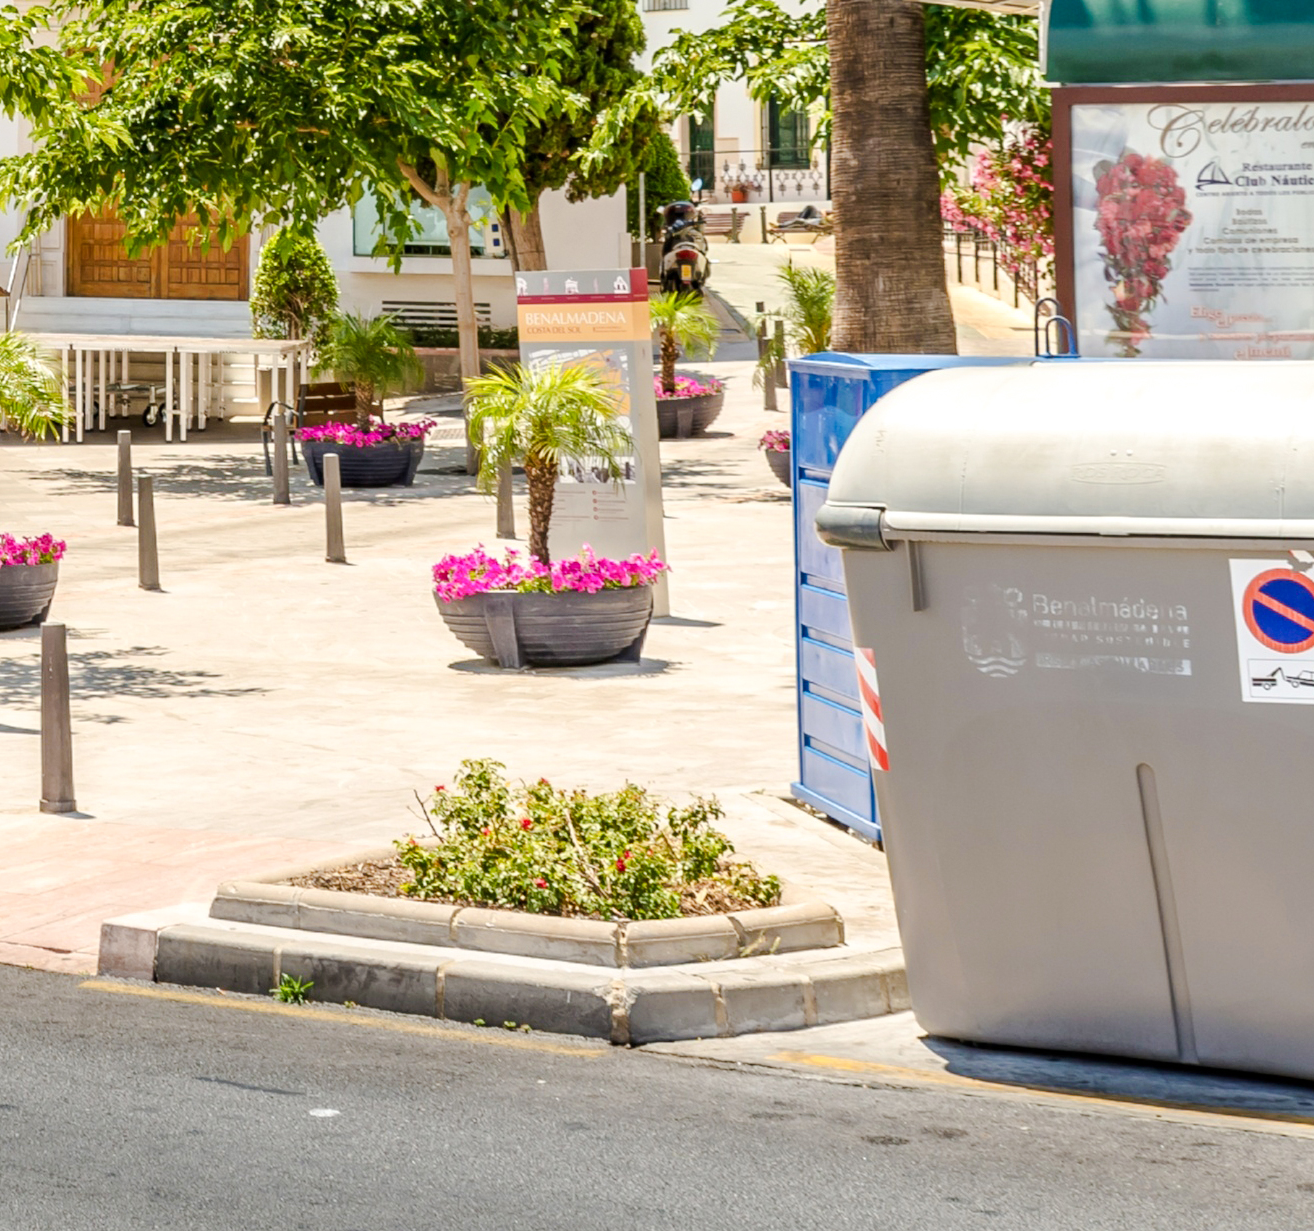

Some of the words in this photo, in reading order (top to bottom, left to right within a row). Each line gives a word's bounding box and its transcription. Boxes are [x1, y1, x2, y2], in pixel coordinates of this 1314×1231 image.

[1242, 163, 1313, 172] Restaurante
[1235, 175, 1267, 187] Club
[525, 311, 626, 325] BENALMADENA
[568, 326, 582, 334] SOL
